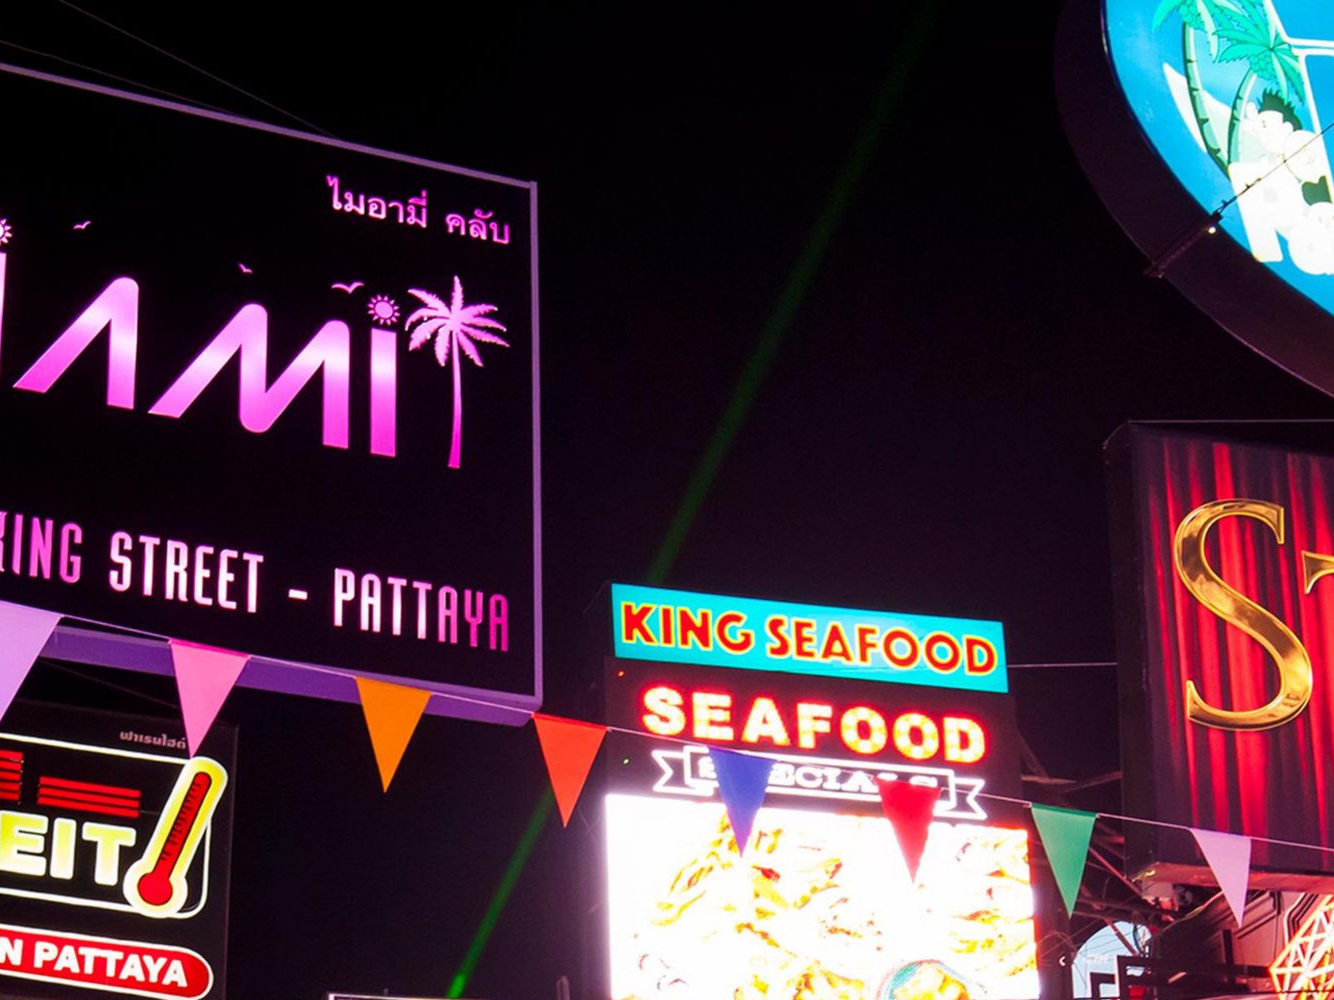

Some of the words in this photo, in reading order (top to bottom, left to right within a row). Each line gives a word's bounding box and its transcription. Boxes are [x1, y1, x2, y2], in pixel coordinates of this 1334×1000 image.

[327, 174, 430, 228] ไมอามี่
[445, 205, 511, 246] คลับ
[109, 531, 265, 616] STREET
[332, 566, 511, 653] PATTAYA
[620, 602, 755, 653] KING
[765, 614, 998, 677] SEAFOOD
[641, 685, 988, 764] SEAFOOD
[32, 940, 189, 988] PATTAYA
